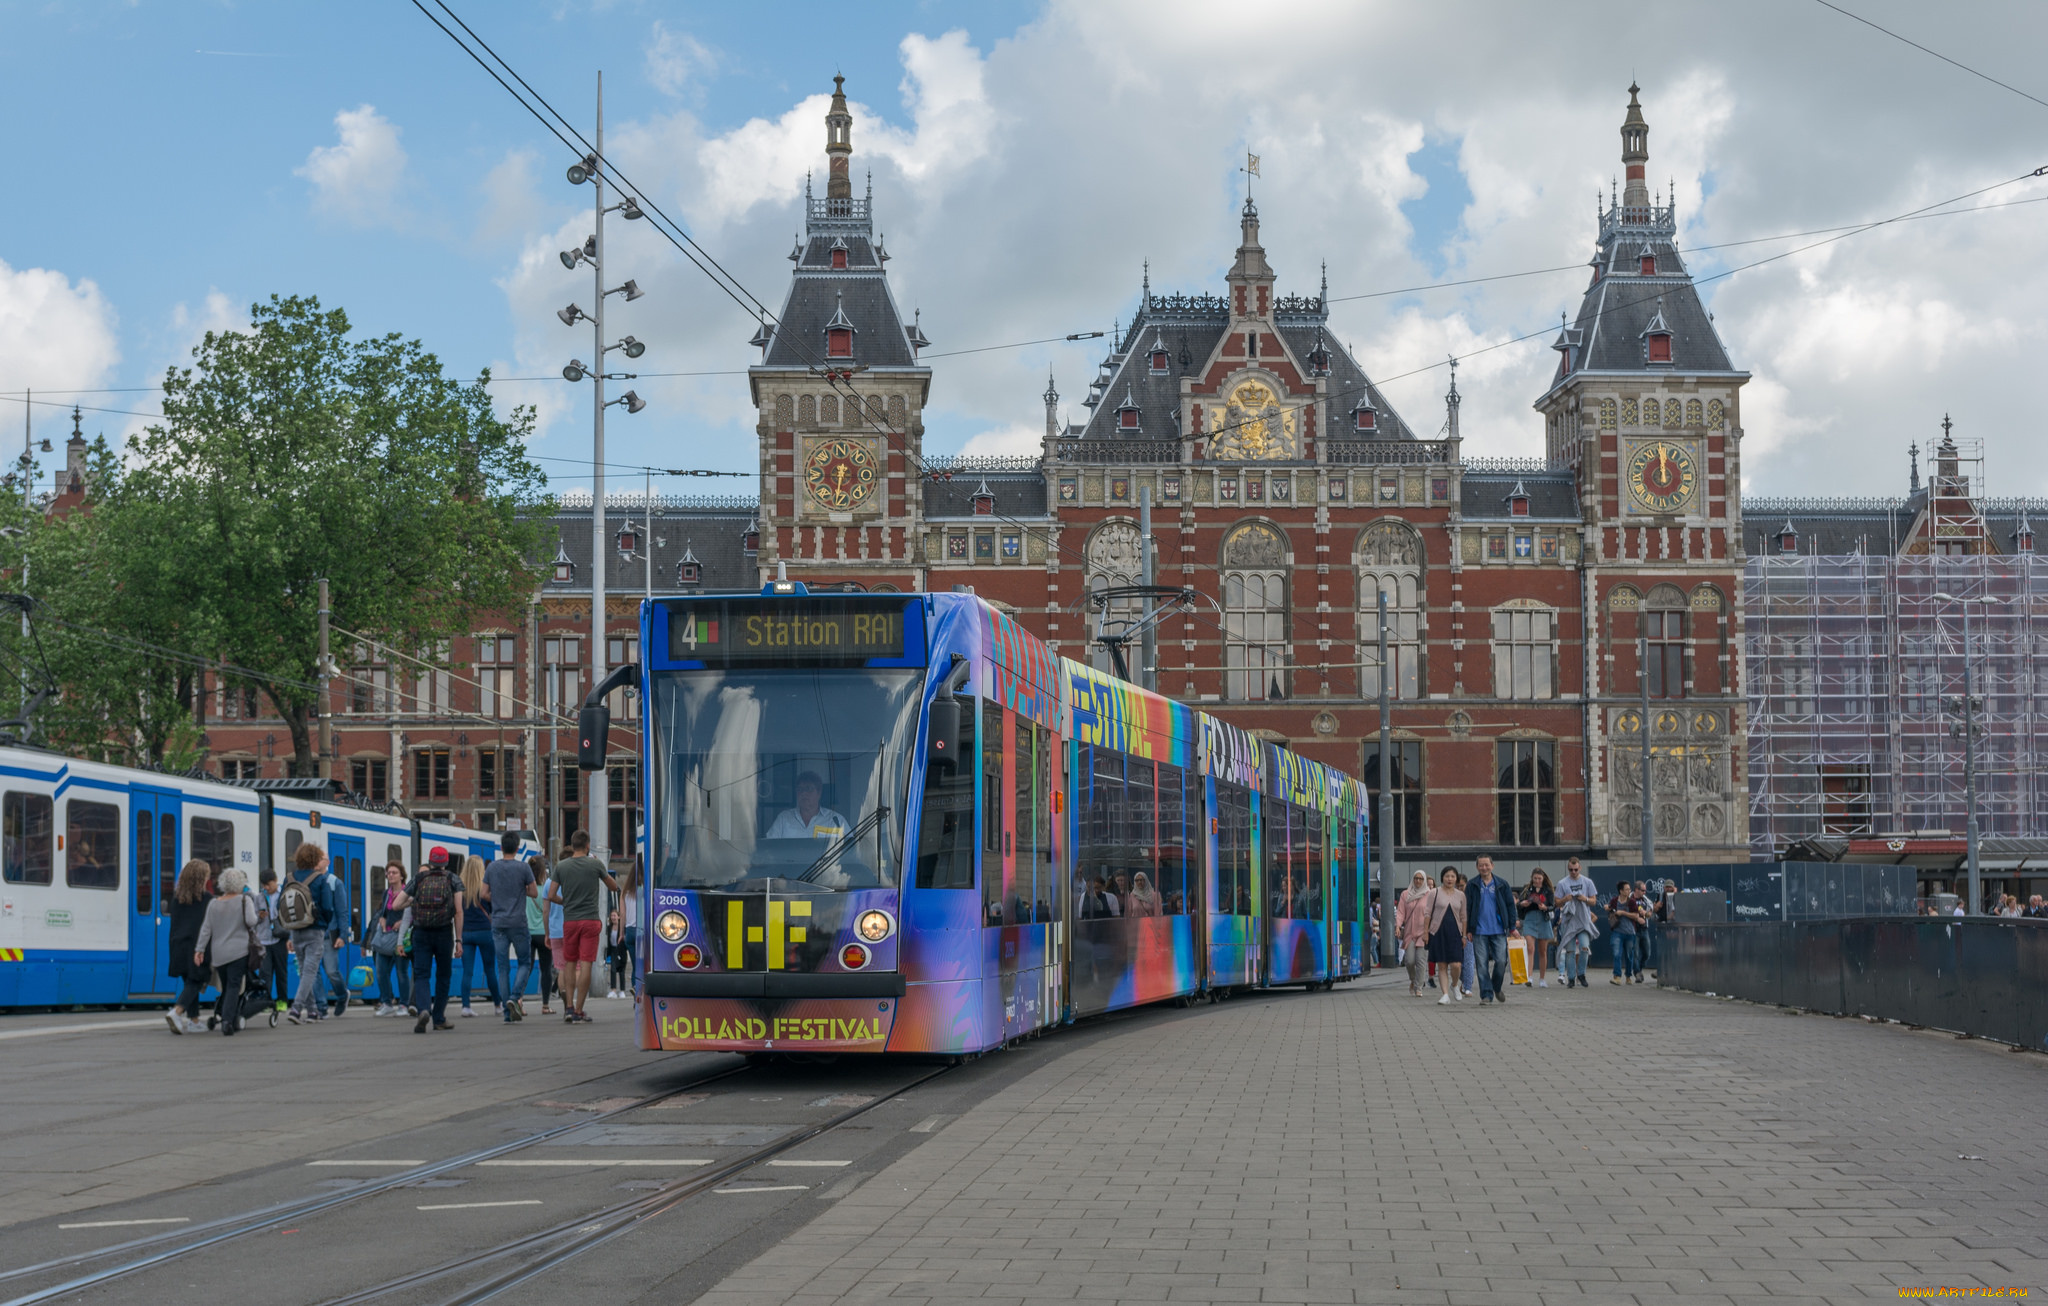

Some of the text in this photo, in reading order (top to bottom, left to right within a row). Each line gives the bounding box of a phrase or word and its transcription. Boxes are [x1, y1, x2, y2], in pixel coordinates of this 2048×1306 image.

[681, 613, 894, 650] 4 Station RAI
[659, 895, 687, 906] 2090
[662, 1016, 886, 1041] HOLLAND FESTIVAL
